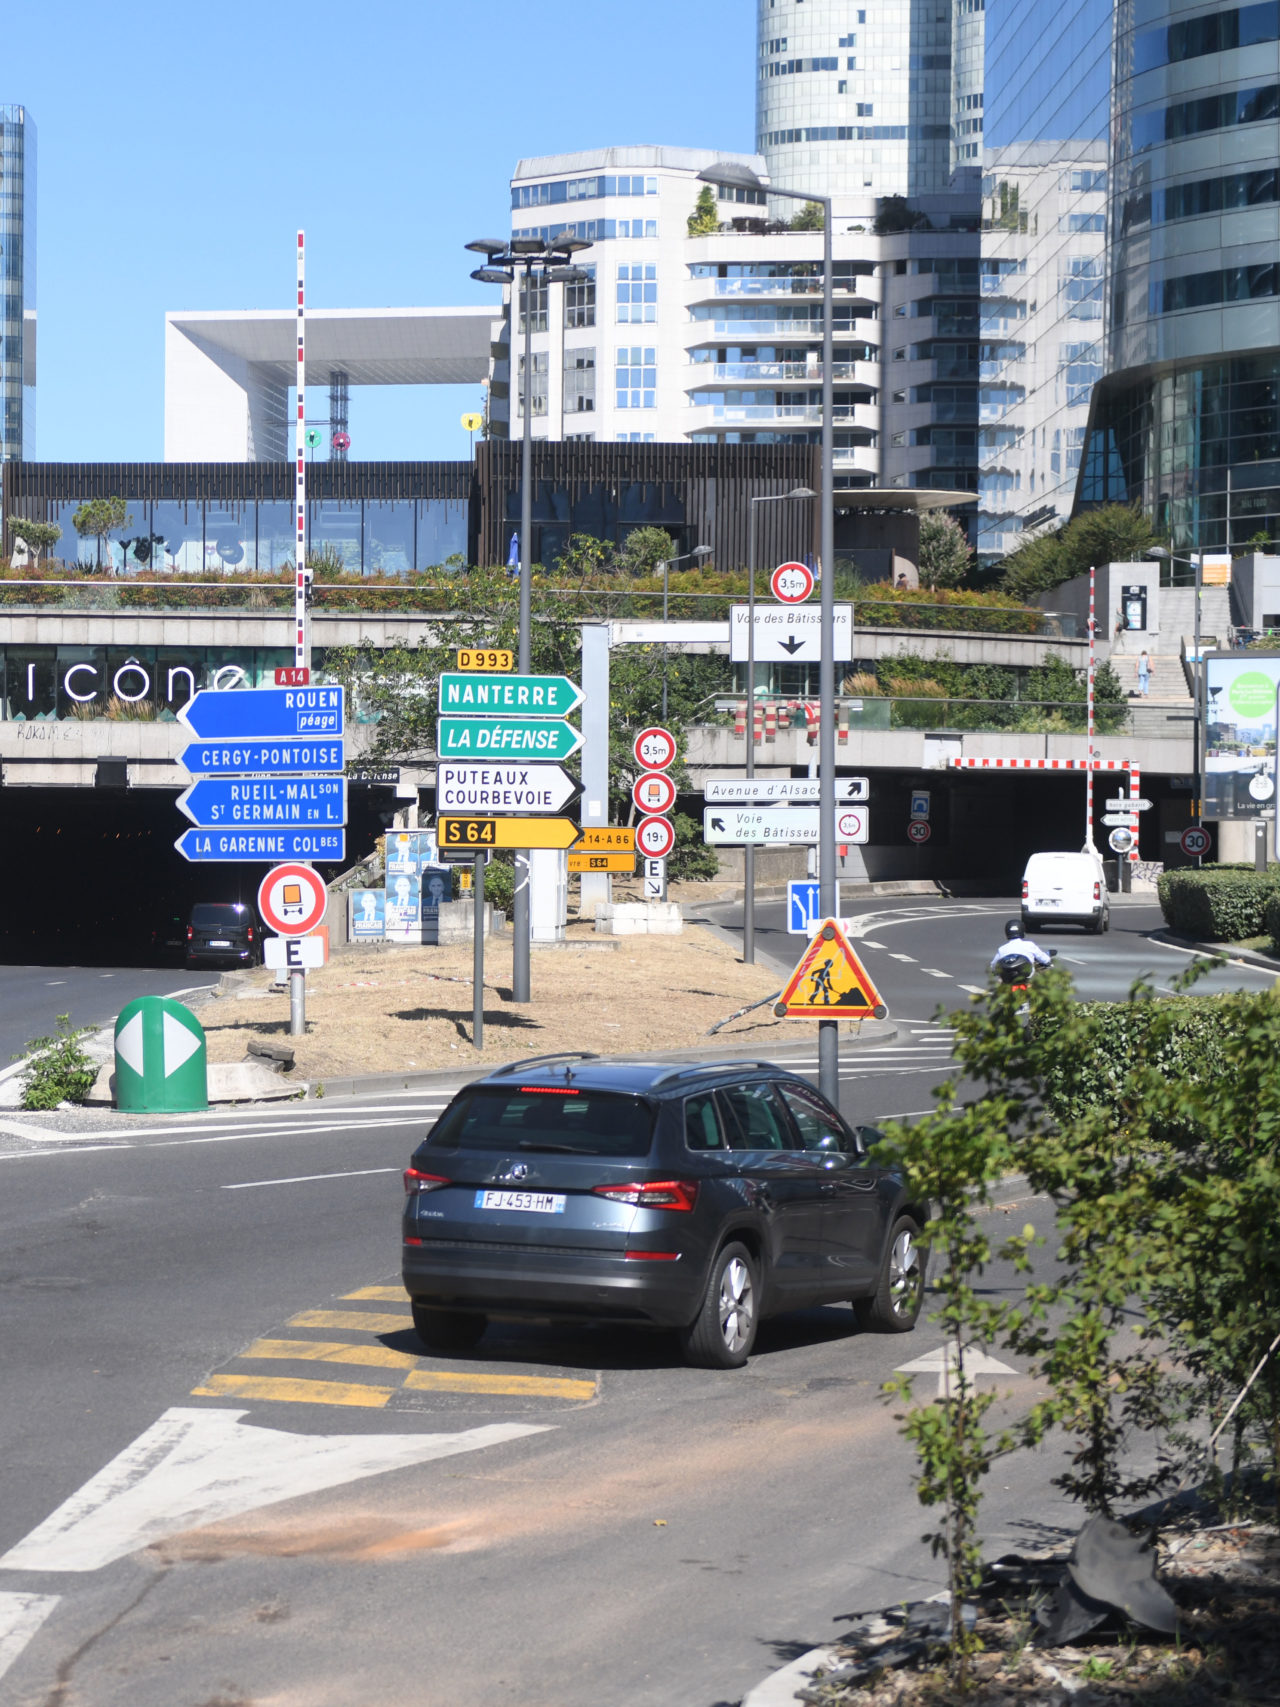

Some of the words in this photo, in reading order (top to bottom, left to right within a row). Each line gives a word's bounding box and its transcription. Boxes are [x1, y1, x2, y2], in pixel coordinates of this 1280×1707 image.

[780, 578, 805, 589] 3,5m
[737, 613, 760, 624] Voe
[764, 613, 784, 624] des
[787, 612, 847, 624] Bâtissrs
[461, 654, 470, 667] D
[477, 653, 509, 668] 993
[279, 671, 287, 683] A
[291, 670, 304, 682] 14
[285, 691, 338, 708] ROUEN
[448, 684, 558, 706] NANTERRE
[300, 713, 335, 728] péage
[447, 729, 470, 748] LA
[476, 725, 559, 750] DÉFENSE
[202, 748, 338, 765] CERGY-PONTOISE
[643, 744, 667, 757] 3,5m
[445, 770, 529, 785] PUTEAUX
[445, 789, 552, 805] COURBEVOIE
[712, 785, 759, 796] Avenue
[233, 804, 300, 820] GERMAIN
[308, 809, 319, 819] EN
[326, 804, 339, 819] L.
[736, 813, 762, 824] Voie
[449, 823, 460, 842] S
[466, 823, 493, 842] 64
[736, 827, 757, 838] des
[763, 827, 819, 838] Bâtisseu
[912, 827, 925, 836] 30
[195, 837, 211, 853] LA
[220, 837, 285, 852] GARENNE
[1187, 835, 1205, 848] 30
[649, 860, 660, 876] E
[286, 940, 302, 966] E
[485, 1193, 554, 1211] FJ-453-HM
